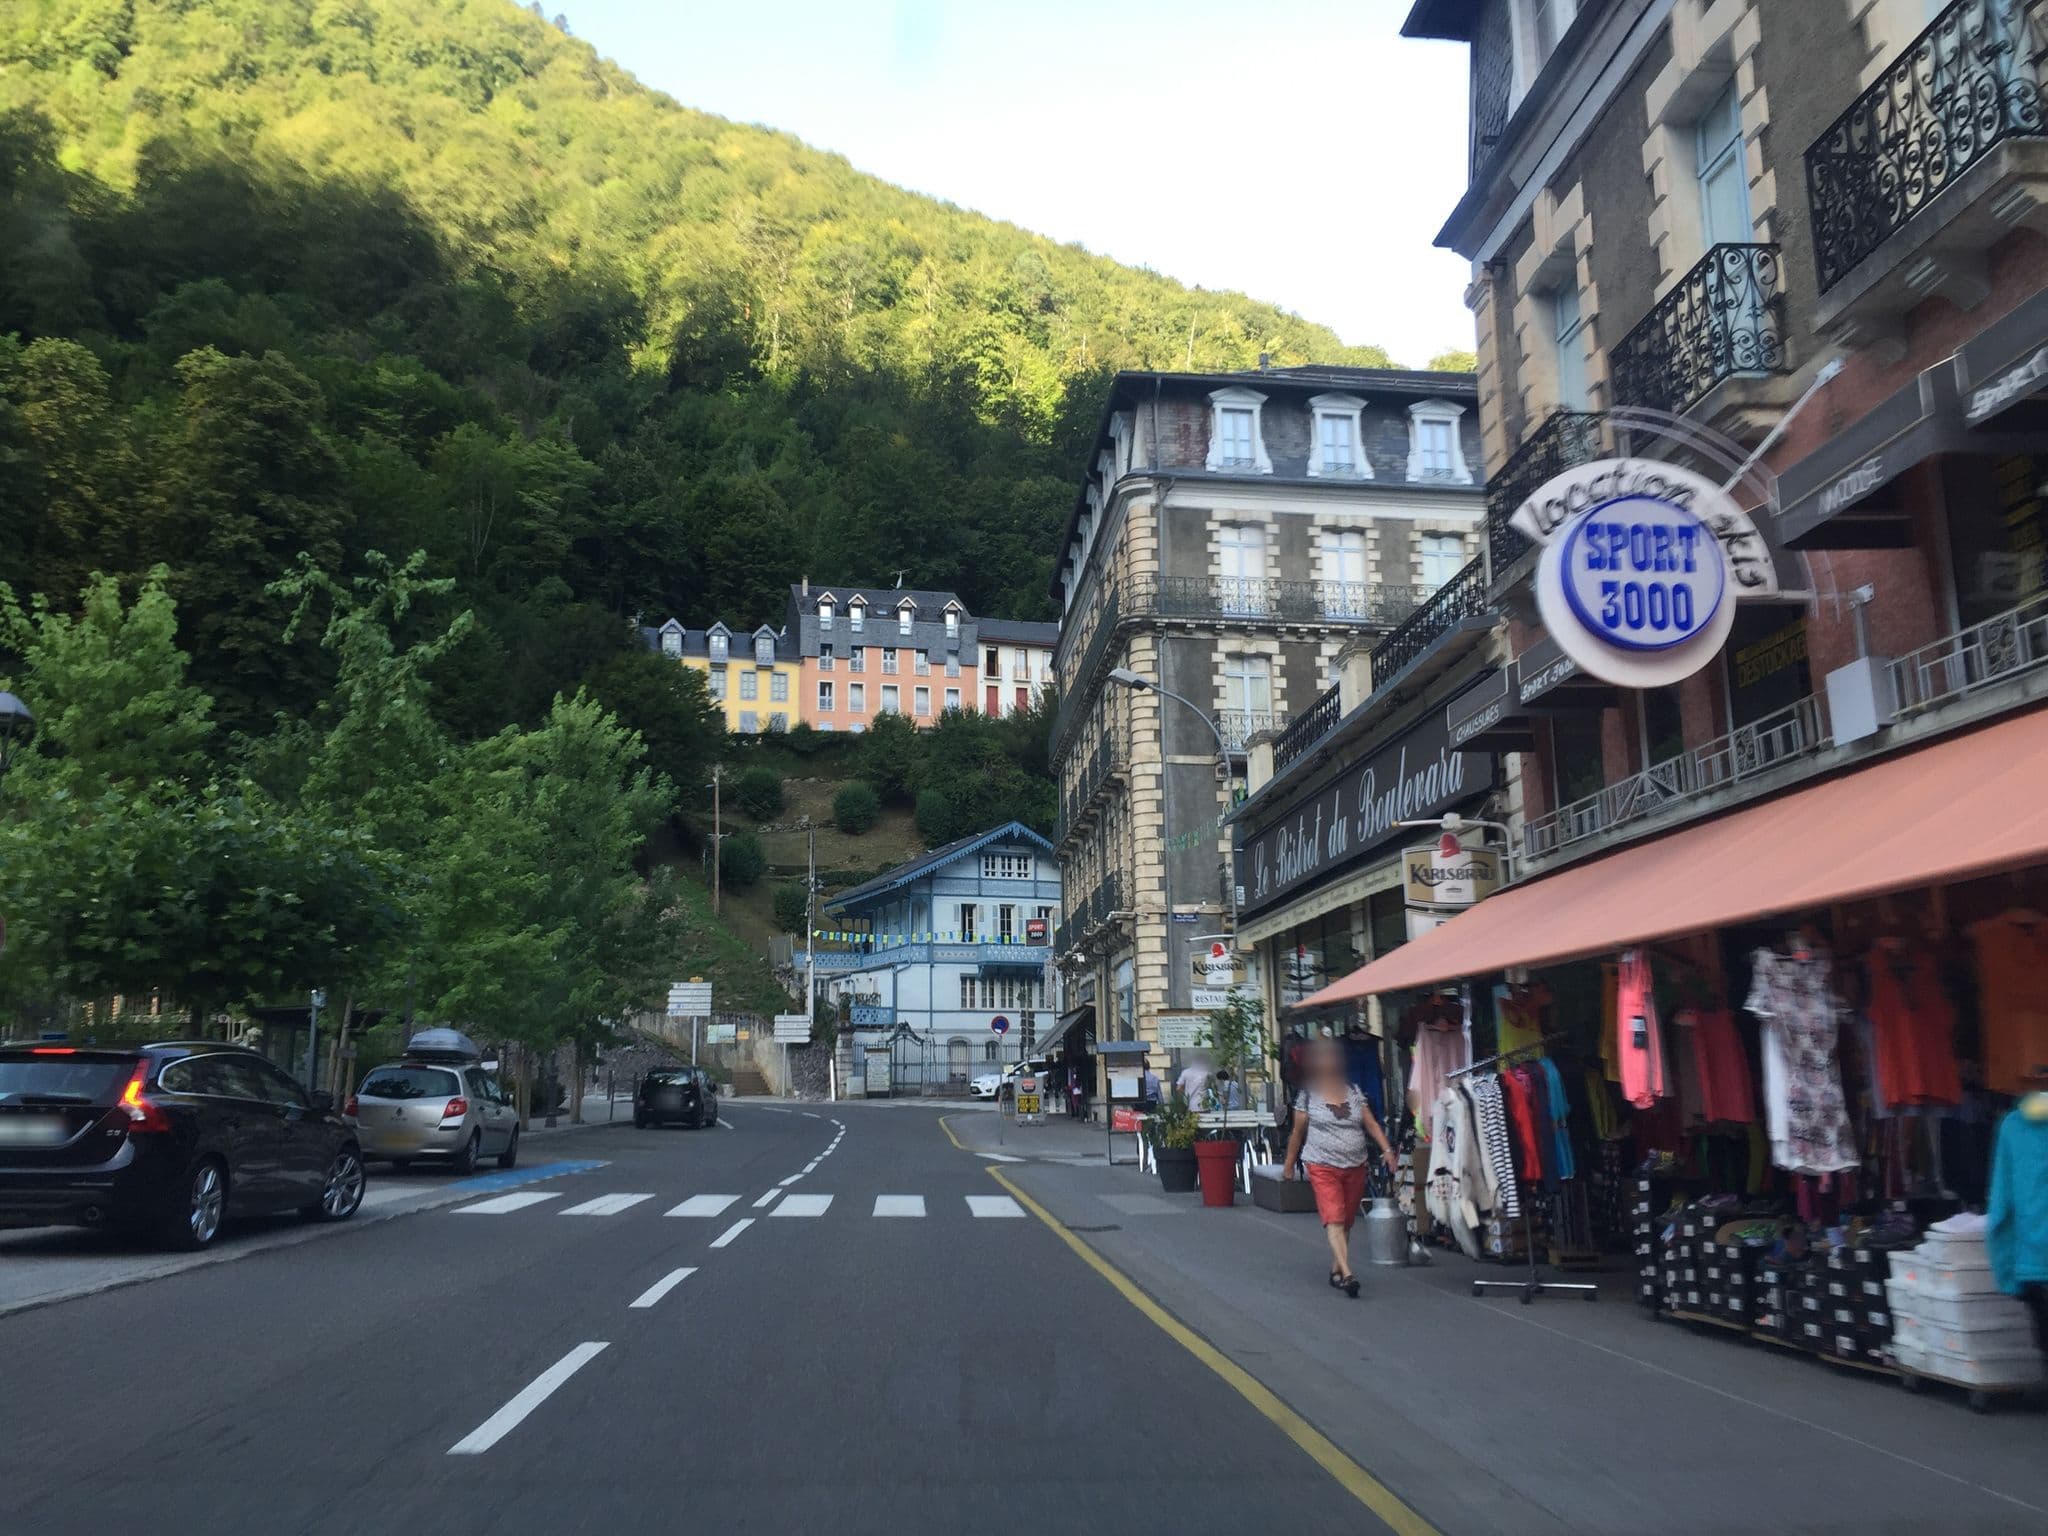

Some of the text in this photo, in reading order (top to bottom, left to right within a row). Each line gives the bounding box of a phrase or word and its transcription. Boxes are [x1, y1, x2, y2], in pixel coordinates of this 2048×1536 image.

[1585, 521, 1701, 574] SPORT
[1600, 580, 1696, 632] 3000
[1455, 704, 1500, 743] CHAUSSURES
[1253, 840, 1270, 900] Le
[1275, 803, 1323, 888] Bistrot
[1328, 789, 1349, 860] du
